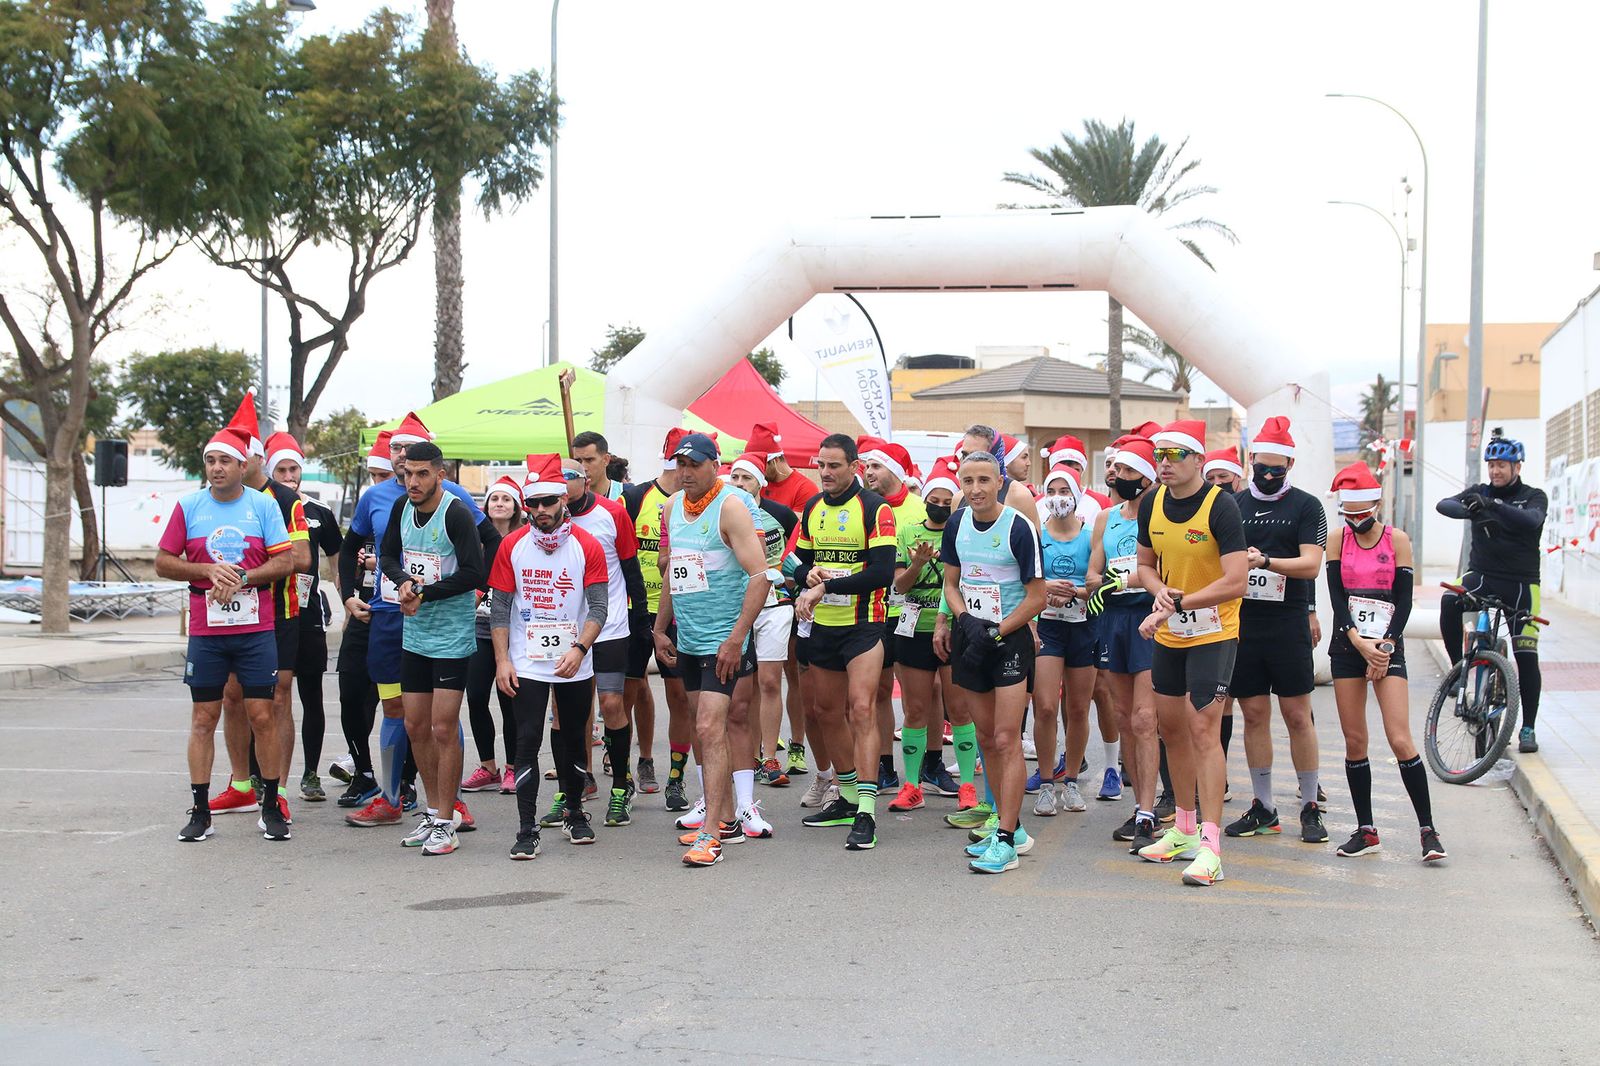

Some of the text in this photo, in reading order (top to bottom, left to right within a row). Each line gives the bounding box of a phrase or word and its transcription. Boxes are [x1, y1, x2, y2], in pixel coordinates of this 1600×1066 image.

[838, 551, 858, 562] BIKE
[410, 563, 425, 575] 62
[522, 569, 553, 579] XII SAN
[673, 566, 688, 579] 59
[1248, 575, 1267, 587] 50
[221, 600, 241, 612] 40
[967, 598, 981, 610] 14
[1180, 611, 1197, 623] 31
[1358, 610, 1376, 622] 51
[541, 635, 561, 647] 33
